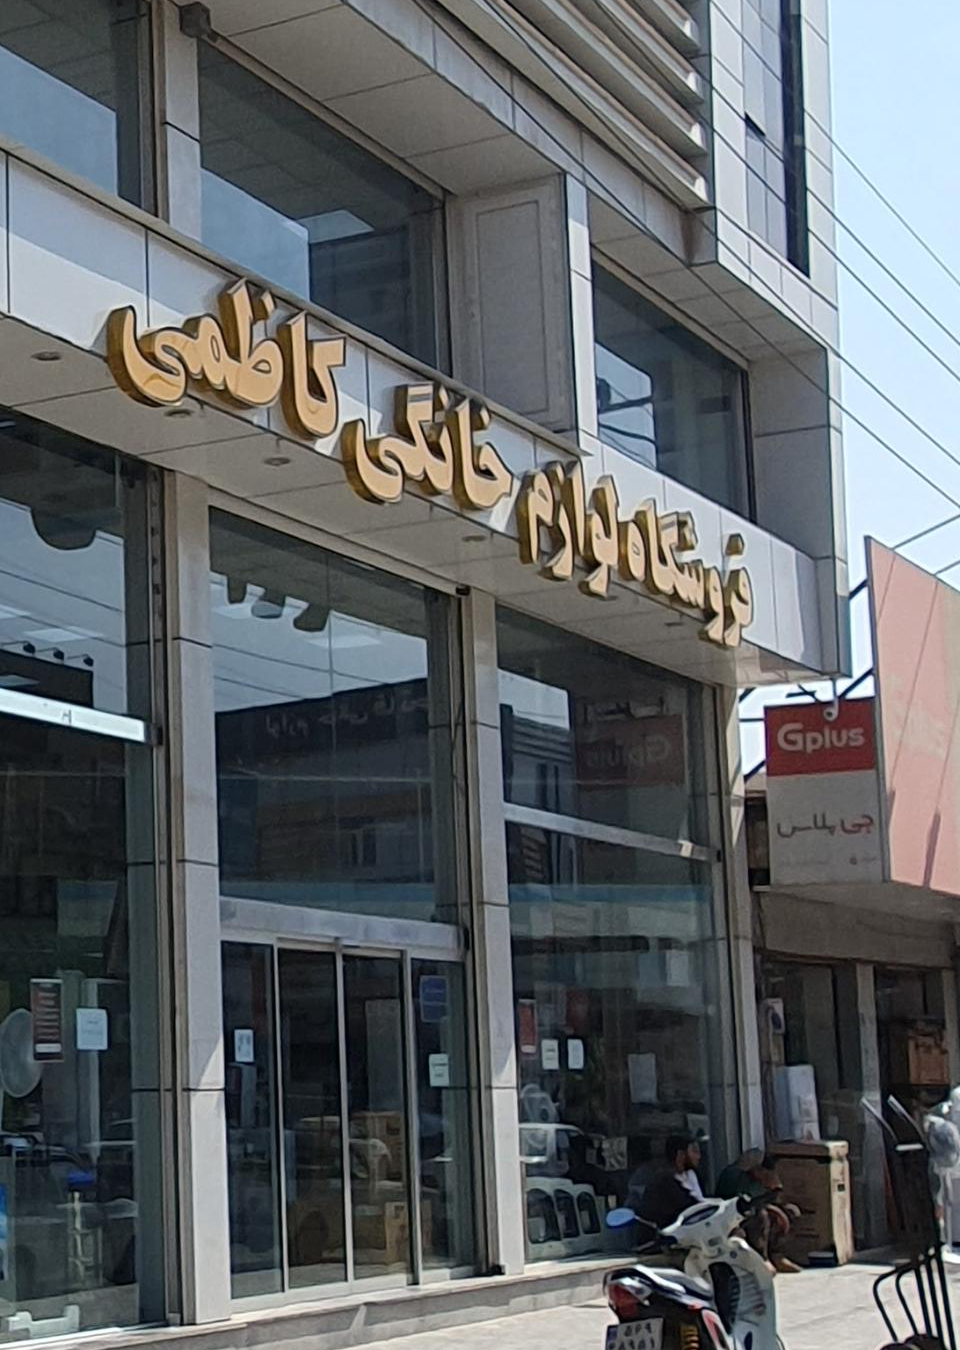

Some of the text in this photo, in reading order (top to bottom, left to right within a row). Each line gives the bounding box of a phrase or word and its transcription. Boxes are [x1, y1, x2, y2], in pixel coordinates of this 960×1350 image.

[105, 277, 754, 648] فروشگاه لوازم خانگی کاظمی
[777, 722, 865, 753] Gplus
[776, 812, 874, 838] جی پلاس
